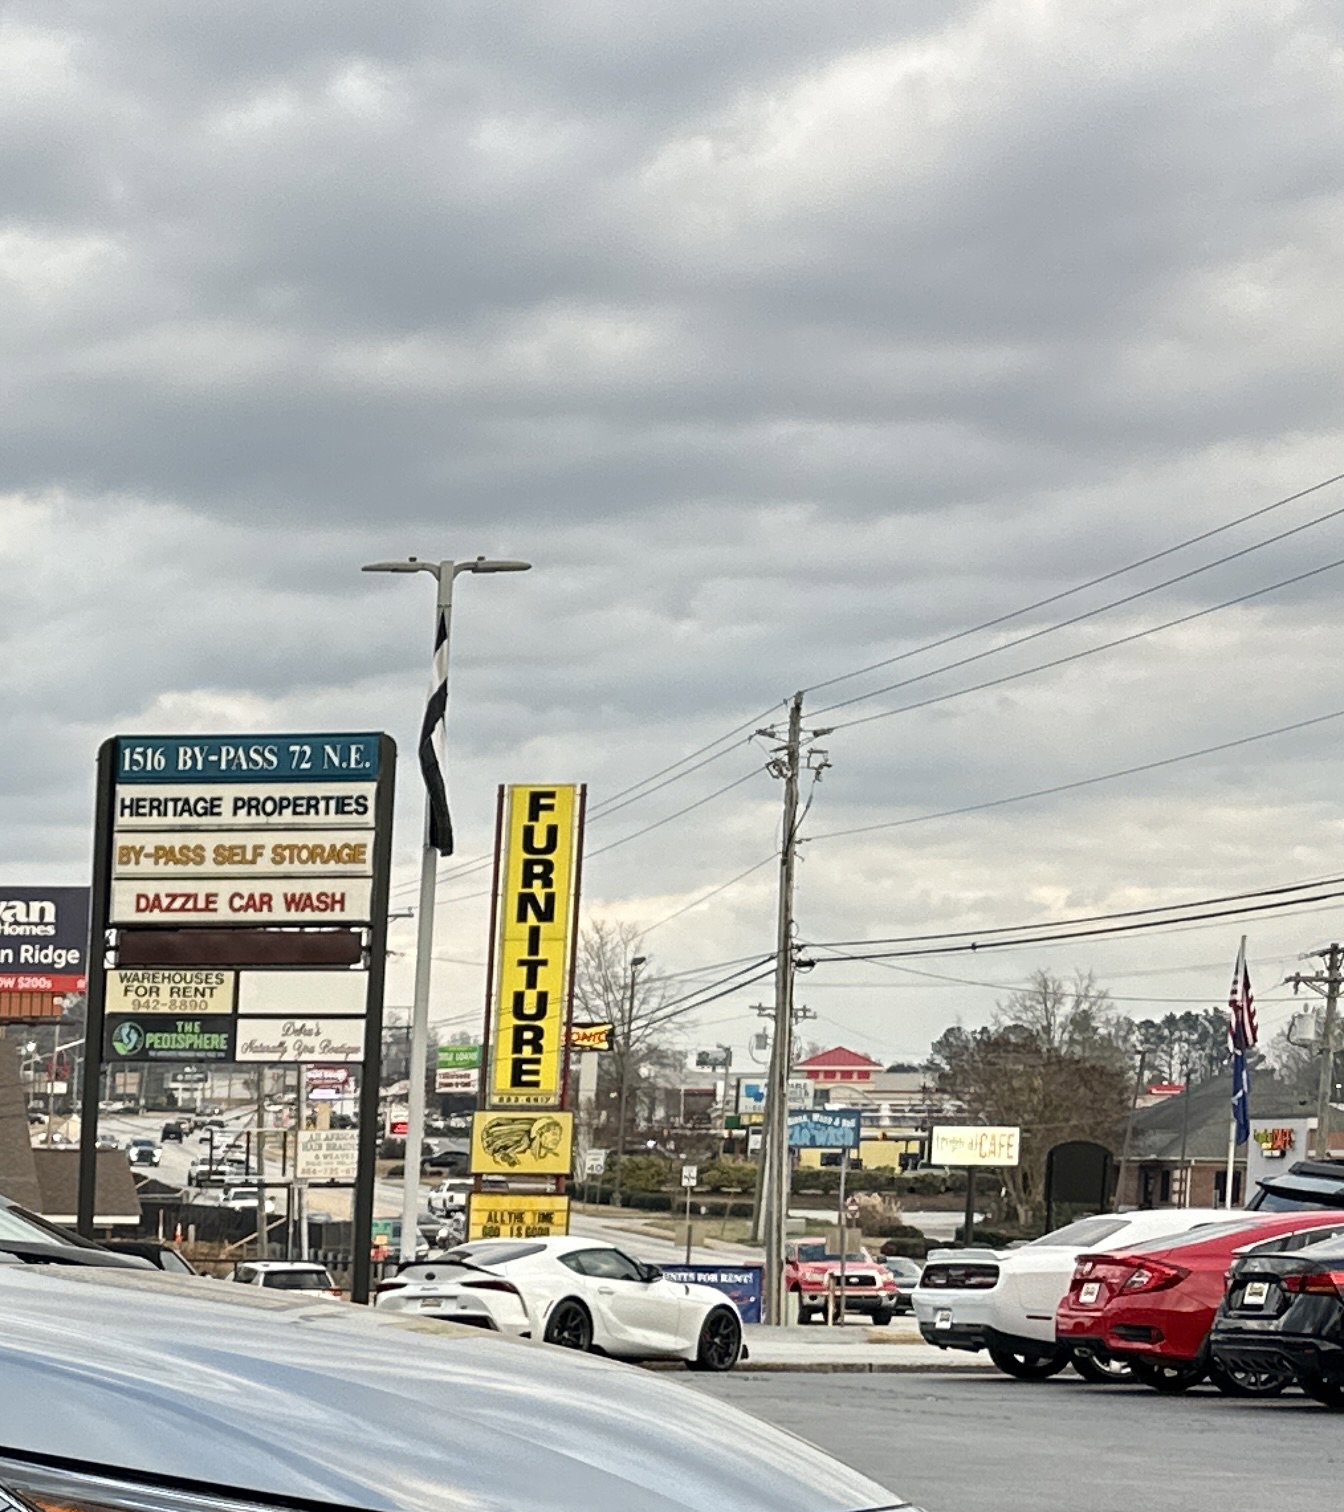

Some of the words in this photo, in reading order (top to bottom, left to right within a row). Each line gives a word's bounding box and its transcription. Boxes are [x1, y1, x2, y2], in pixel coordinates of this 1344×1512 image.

[121, 746, 166, 771] 1516
[177, 745, 278, 771] BY-PASS
[289, 745, 312, 769] 72
[323, 744, 371, 769] N.E.
[119, 796, 223, 817] HERITAGE
[232, 794, 369, 816] PROPERTIES
[117, 844, 206, 866] BY-PASS
[212, 844, 265, 865] SELF
[271, 843, 367, 865] STORAGE
[135, 893, 218, 913] DAZZLE
[229, 892, 273, 912] CAR
[283, 892, 345, 912] WASH
[510, 791, 558, 1089] FURNITURE
[20, 944, 80, 968] Ridge
[119, 972, 225, 985] WAREHOUSES
[123, 985, 160, 997] FOR
[169, 986, 218, 998] RENT
[176, 1021, 201, 1033] THE
[145, 1033, 228, 1049] PEDISPHERE
